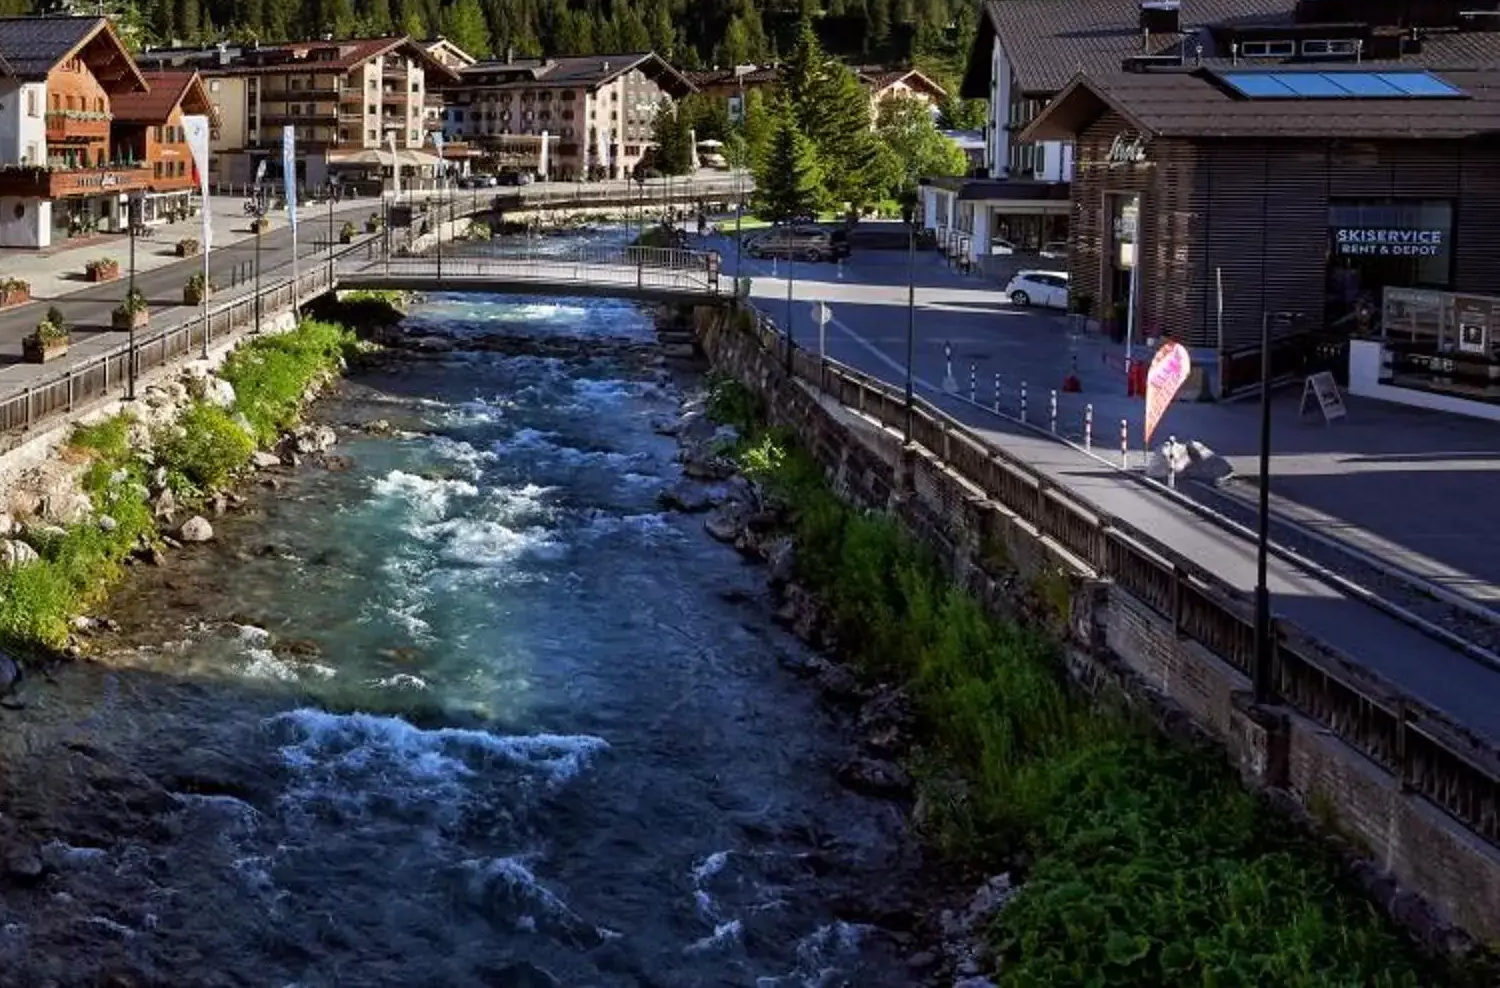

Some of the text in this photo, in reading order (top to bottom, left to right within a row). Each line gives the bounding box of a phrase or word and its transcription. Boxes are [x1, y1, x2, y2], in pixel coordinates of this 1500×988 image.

[1337, 229, 1442, 243] SKISERVICE
[1341, 244, 1438, 255] RENT & DEPOT
